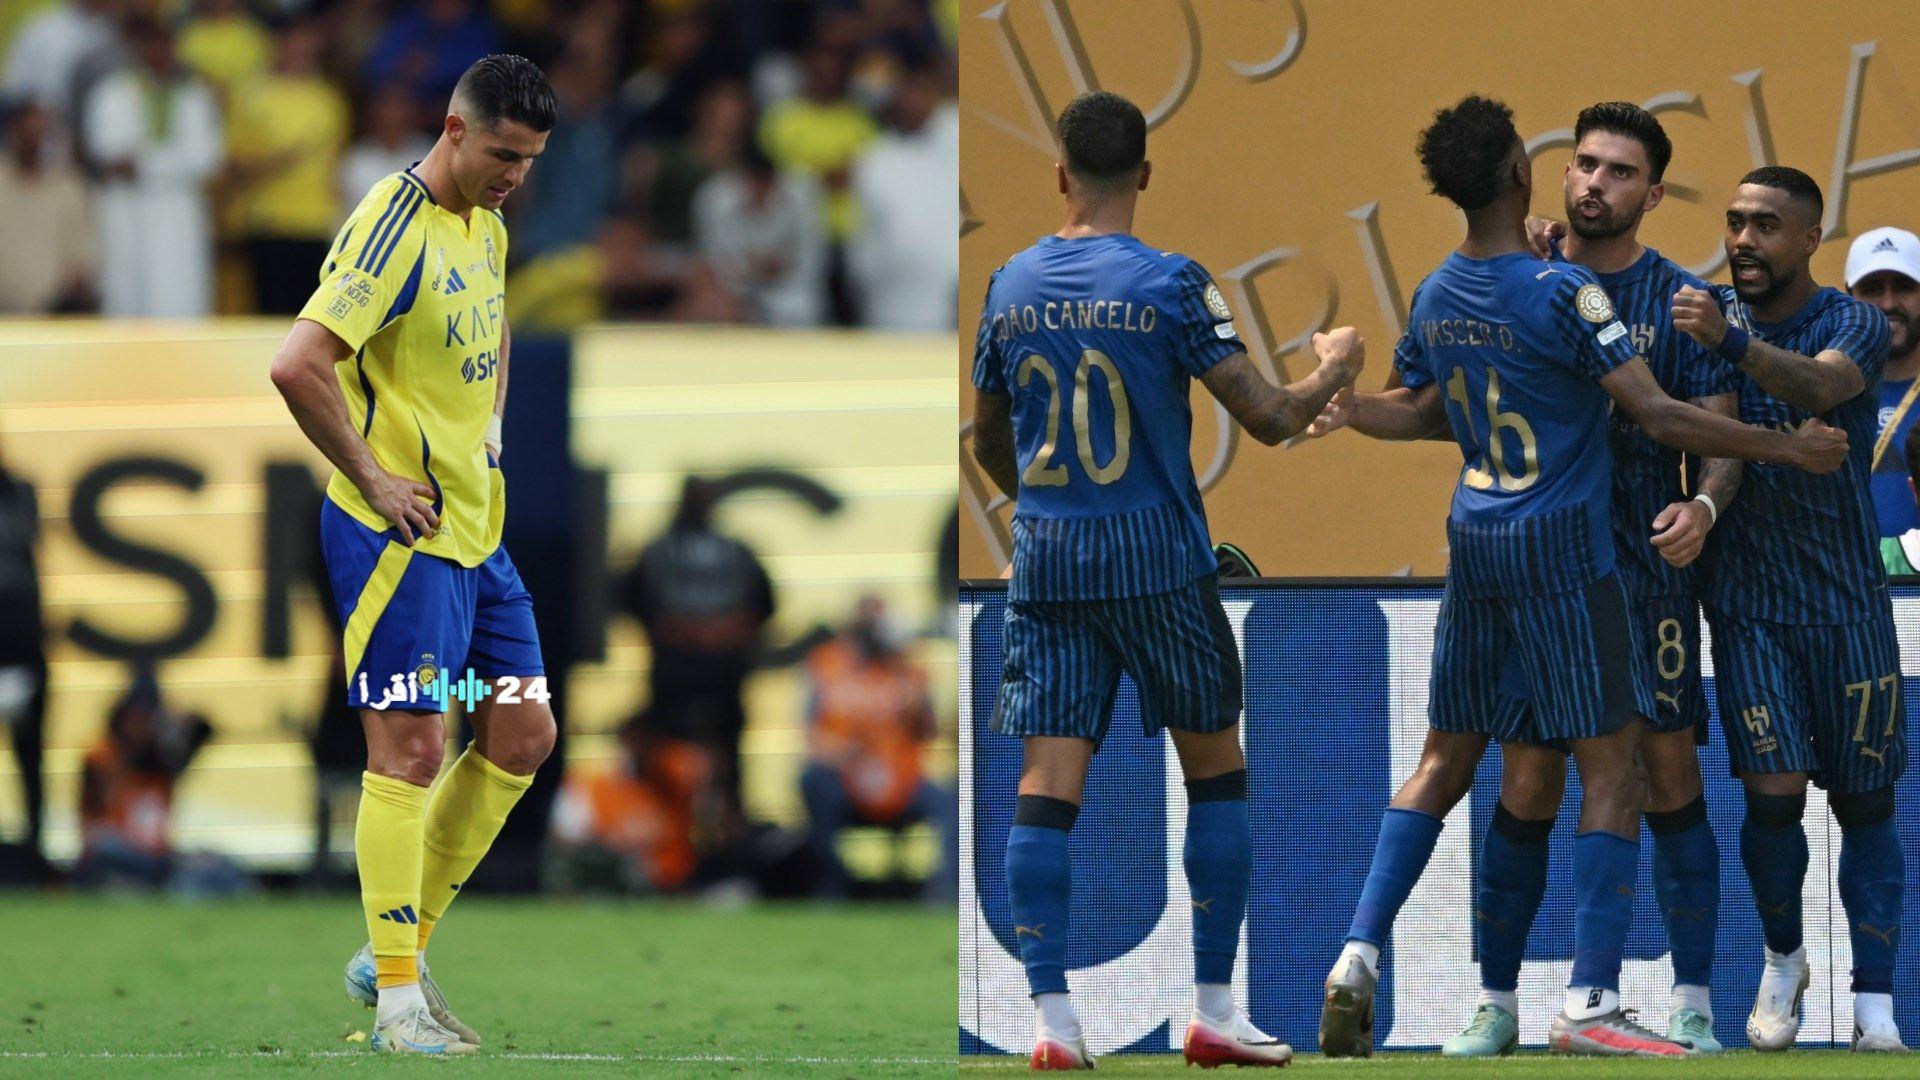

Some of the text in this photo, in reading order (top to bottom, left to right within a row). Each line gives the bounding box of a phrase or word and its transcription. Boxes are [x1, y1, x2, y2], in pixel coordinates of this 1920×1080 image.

[1044, 299, 1157, 333] CANCELO
[1017, 348, 1131, 486] 20
[1446, 365, 1540, 491] 16
[1656, 617, 1686, 681] 8
[1844, 672, 1898, 743] 77
